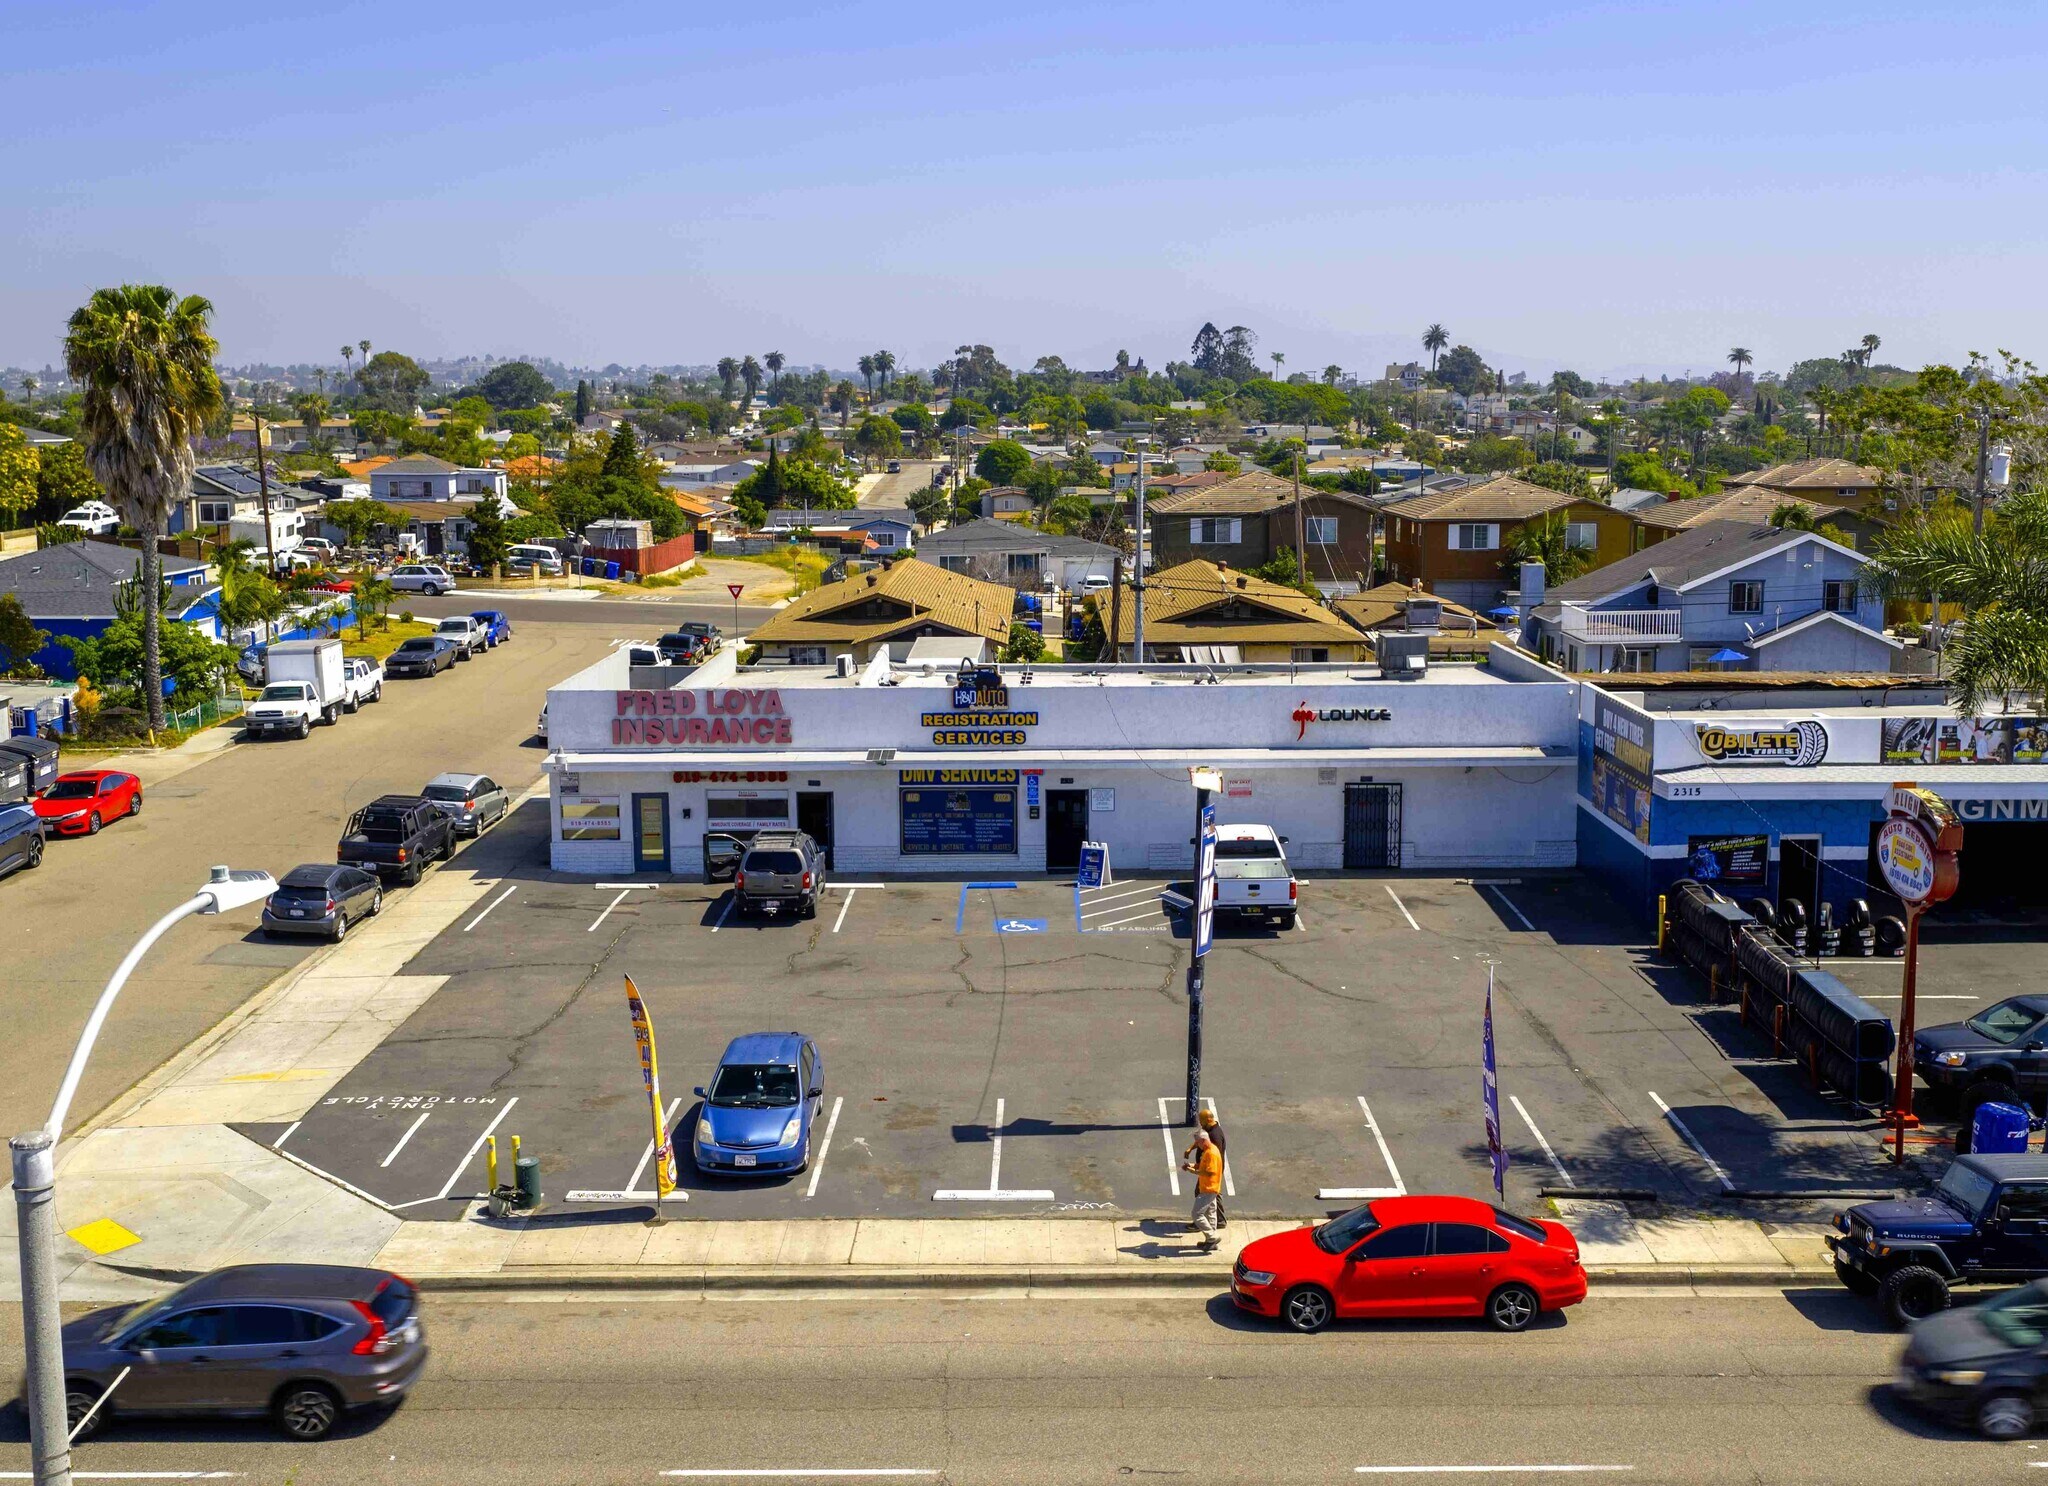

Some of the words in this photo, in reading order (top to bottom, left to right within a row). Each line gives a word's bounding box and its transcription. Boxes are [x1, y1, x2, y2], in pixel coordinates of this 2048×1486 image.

[609, 639, 659, 647] YIEL
[616, 690, 696, 715] FRED
[707, 690, 785, 715] LOYA
[922, 713, 1037, 726] REGISTRATION
[1319, 709, 1391, 721] LOUNGE
[612, 718, 793, 745] INSURANCE
[1603, 708, 1613, 730] BUY
[1629, 721, 1644, 747] TIRES
[933, 731, 1026, 745] SERVICES
[1701, 728, 1799, 756] CUBILETE
[1939, 750, 1974, 758] Alignment
[2016, 750, 2042, 758] Brakes
[902, 769, 936, 783] DMV
[941, 769, 1016, 783] SERVICES
[1673, 787, 1701, 797] 2315
[1894, 792, 1919, 815] ALIGN
[1947, 799, 2048, 820] GNM
[1883, 823, 1903, 839] AUTO
[1905, 827, 1932, 865] REPAIR
[323, 1096, 496, 1105] MOTORCYCLE
